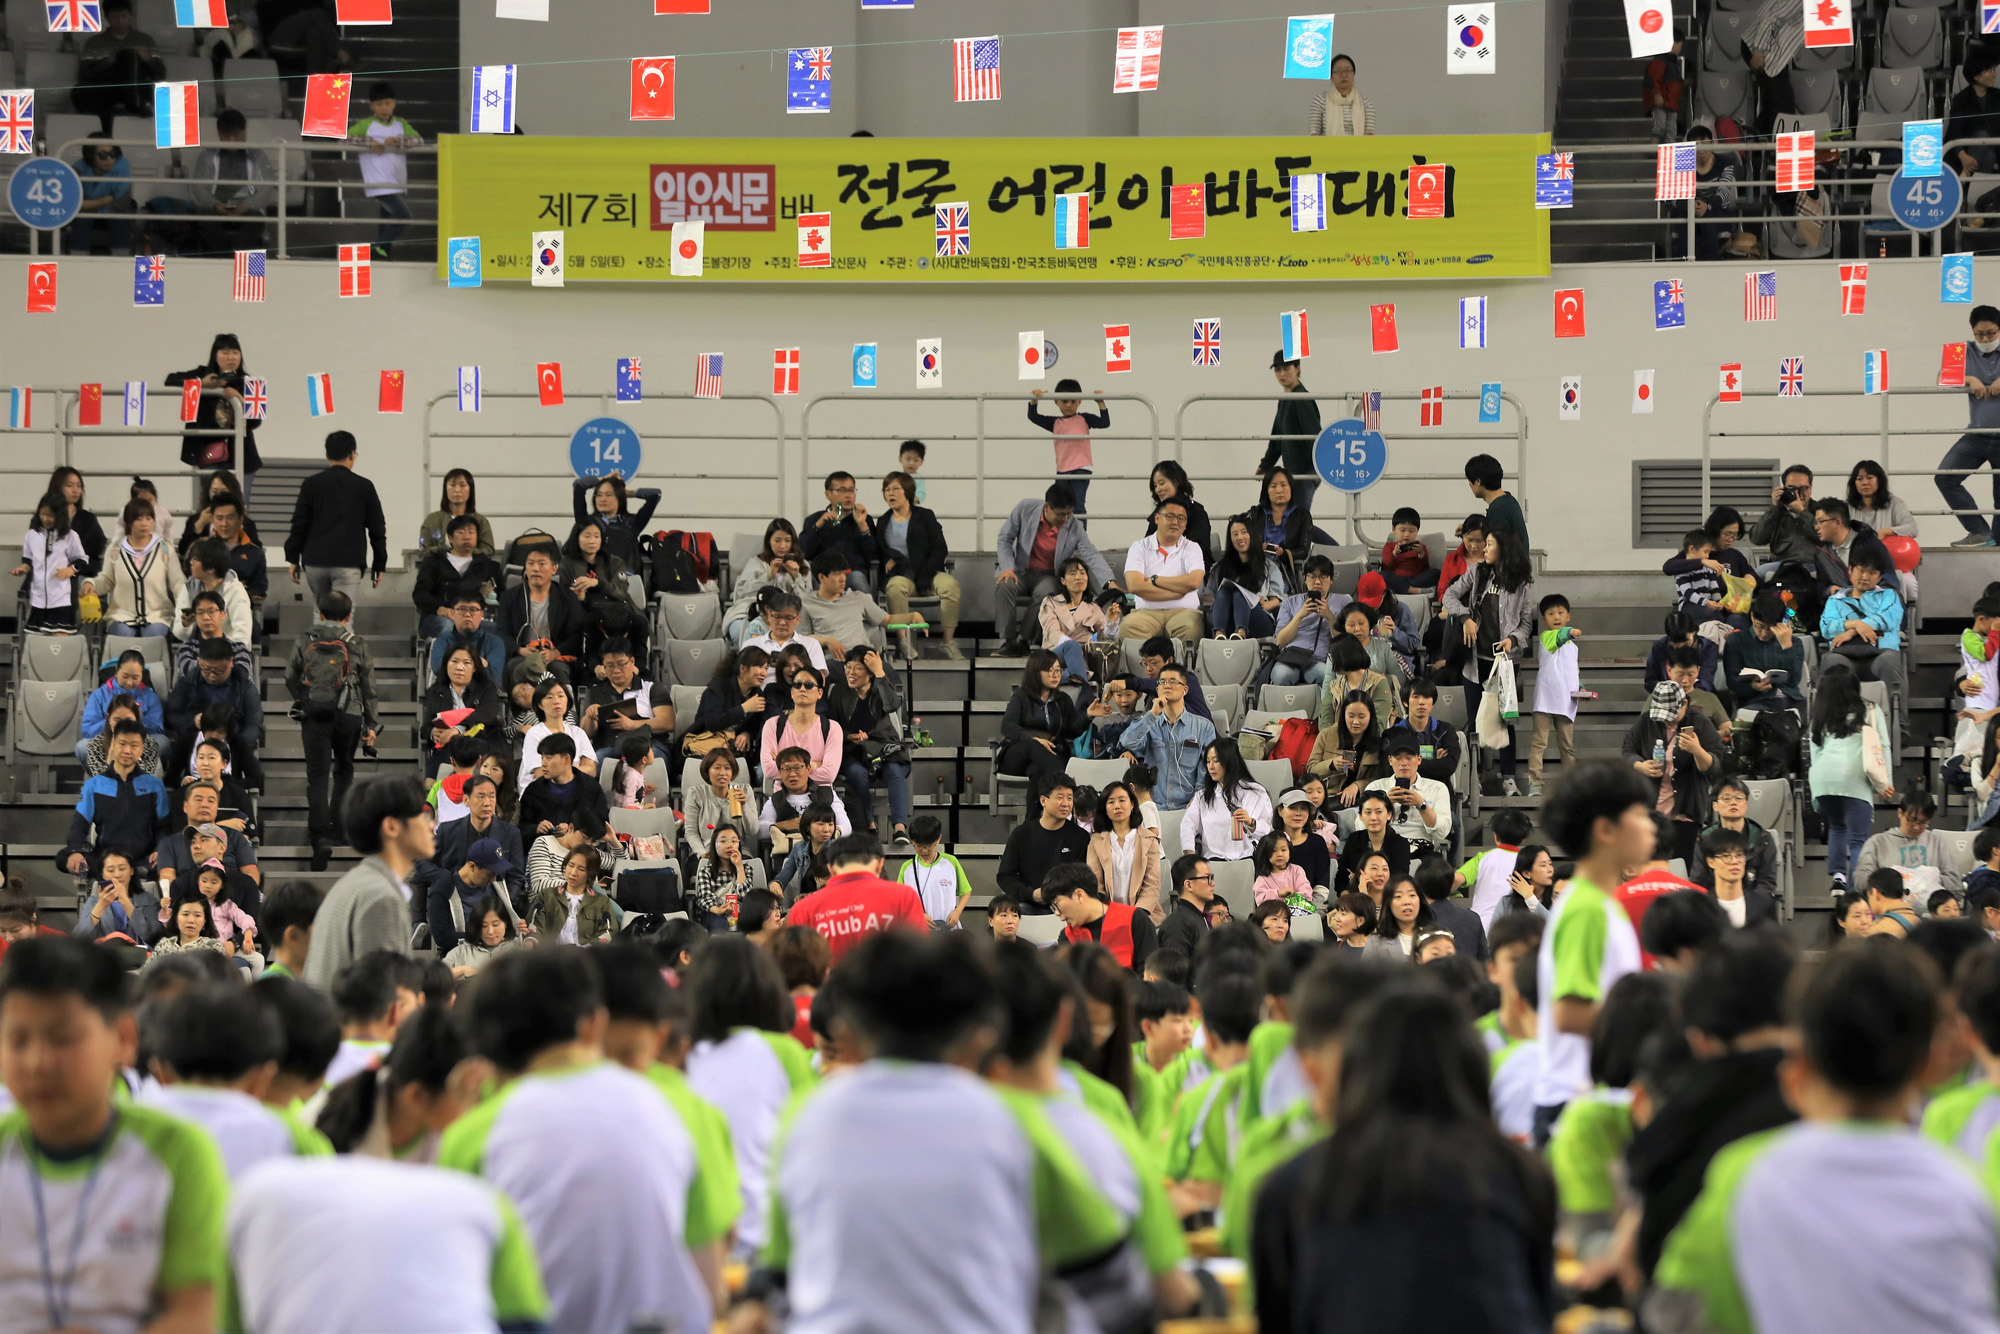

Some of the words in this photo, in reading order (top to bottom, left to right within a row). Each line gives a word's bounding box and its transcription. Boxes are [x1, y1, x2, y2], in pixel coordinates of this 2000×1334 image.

[27, 178, 63, 204] 43
[538, 192, 637, 228] 제7회
[654, 171, 769, 225] 일요신문
[1906, 180, 1943, 205] 45
[31, 208, 42, 216] 42
[1909, 209, 1921, 217] 44
[1928, 209, 1939, 217] 46
[645, 256, 665, 268] 장소
[771, 256, 791, 269] 주최
[886, 257, 906, 269] 주관
[1116, 256, 1136, 268] 후원
[1147, 257, 1183, 267] KSPO
[1197, 256, 1271, 267] 국민체육진흥공단
[1400, 258, 1420, 266] WON
[589, 438, 622, 463] 14
[1334, 439, 1367, 466] 15
[590, 468, 600, 476] 13
[1335, 469, 1345, 477] 14
[1355, 469, 1365, 478] 16
[816, 915, 862, 938] Club
